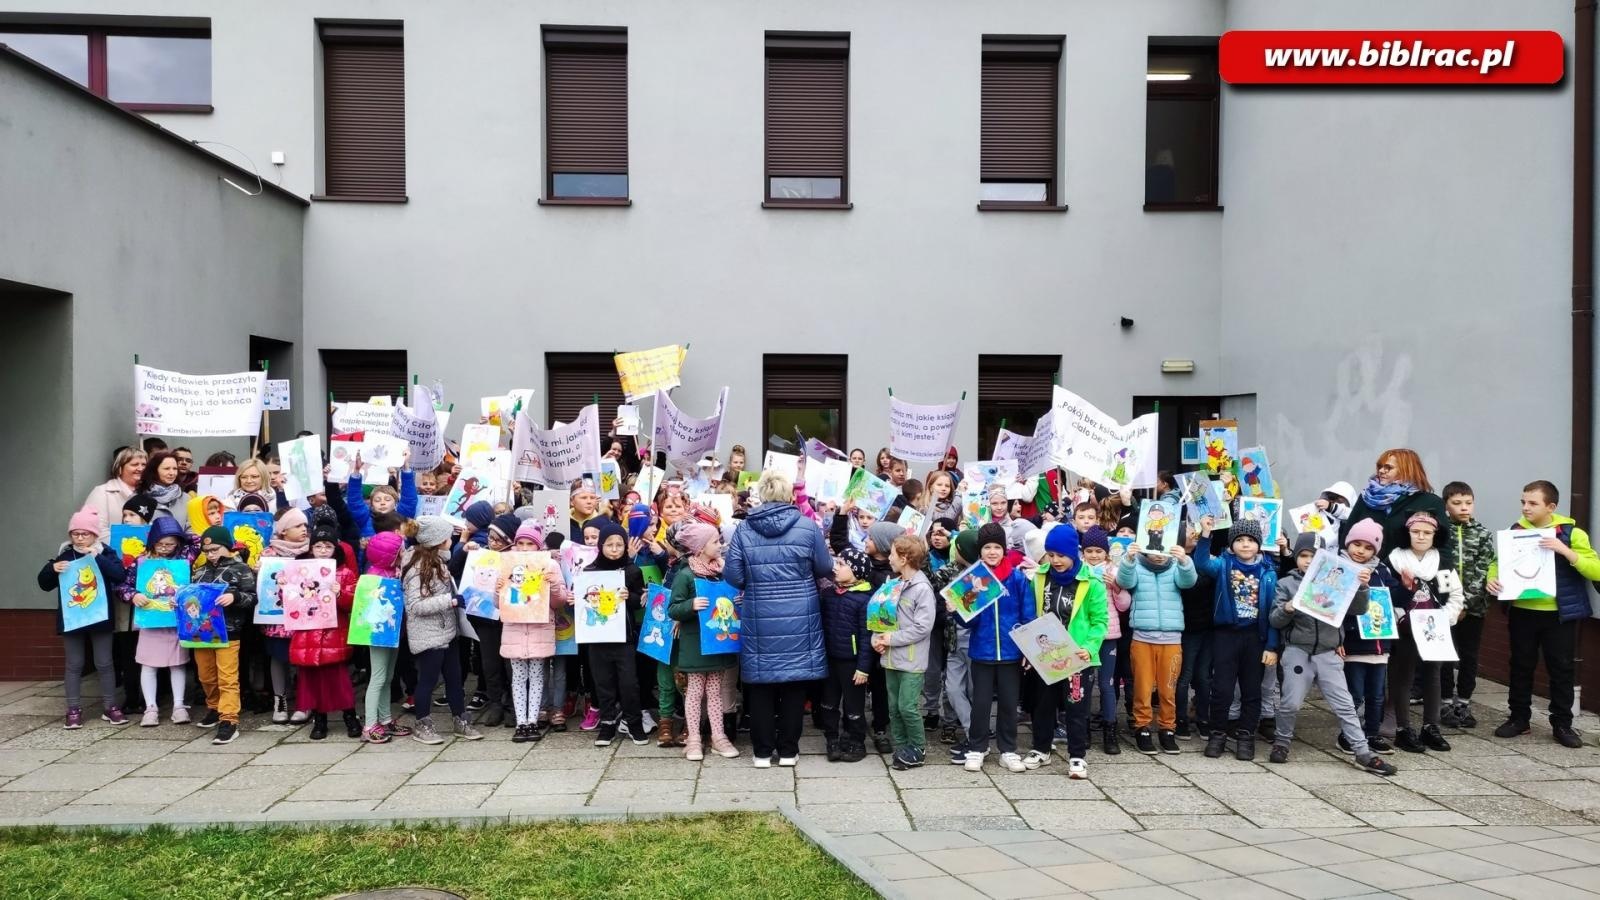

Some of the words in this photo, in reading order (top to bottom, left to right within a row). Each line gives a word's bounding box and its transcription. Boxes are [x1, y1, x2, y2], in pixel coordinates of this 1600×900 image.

[171, 376, 210, 386] człowiek
[143, 380, 166, 393] jakąś
[205, 388, 215, 396] to
[216, 387, 234, 397] jest
[243, 384, 257, 395] nią
[150, 394, 188, 406] związany
[190, 398, 204, 407] już
[206, 398, 219, 406] do
[221, 396, 252, 406] końca
[915, 413, 935, 422] jakie
[1084, 413, 1098, 428] bez
[1071, 420, 1091, 436] ciało
[1091, 432, 1107, 445] bez
[549, 460, 566, 468] kim
